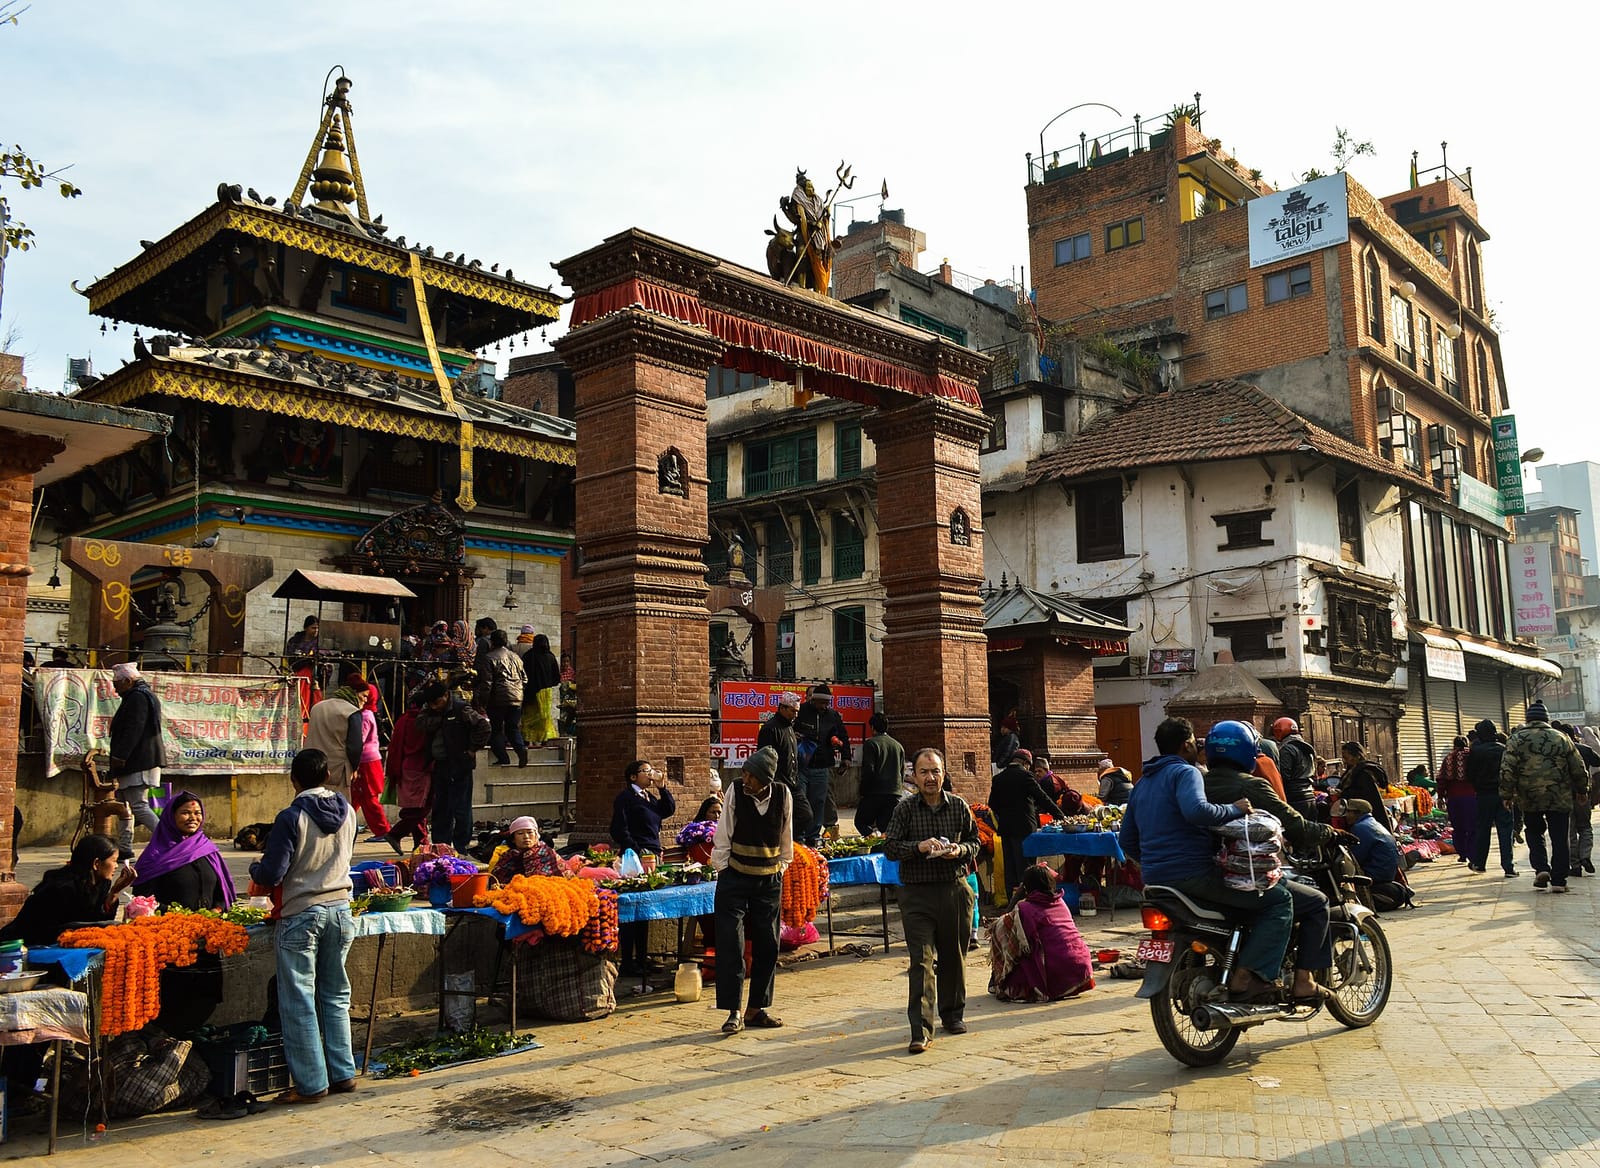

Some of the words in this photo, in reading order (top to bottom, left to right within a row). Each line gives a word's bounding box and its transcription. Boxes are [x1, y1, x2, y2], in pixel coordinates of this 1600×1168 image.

[1279, 217, 1290, 227] de
[1275, 217, 1322, 241] taleju
[1281, 237, 1304, 249] view
[1495, 438, 1519, 451] SQUARE
[1497, 450, 1518, 463] SAVING
[1505, 463, 1513, 474] &
[1500, 475, 1521, 486] CREDIT
[724, 689, 764, 707] महादेव
[837, 696, 871, 709] मण्डल
[185, 747, 228, 759] महादेव
